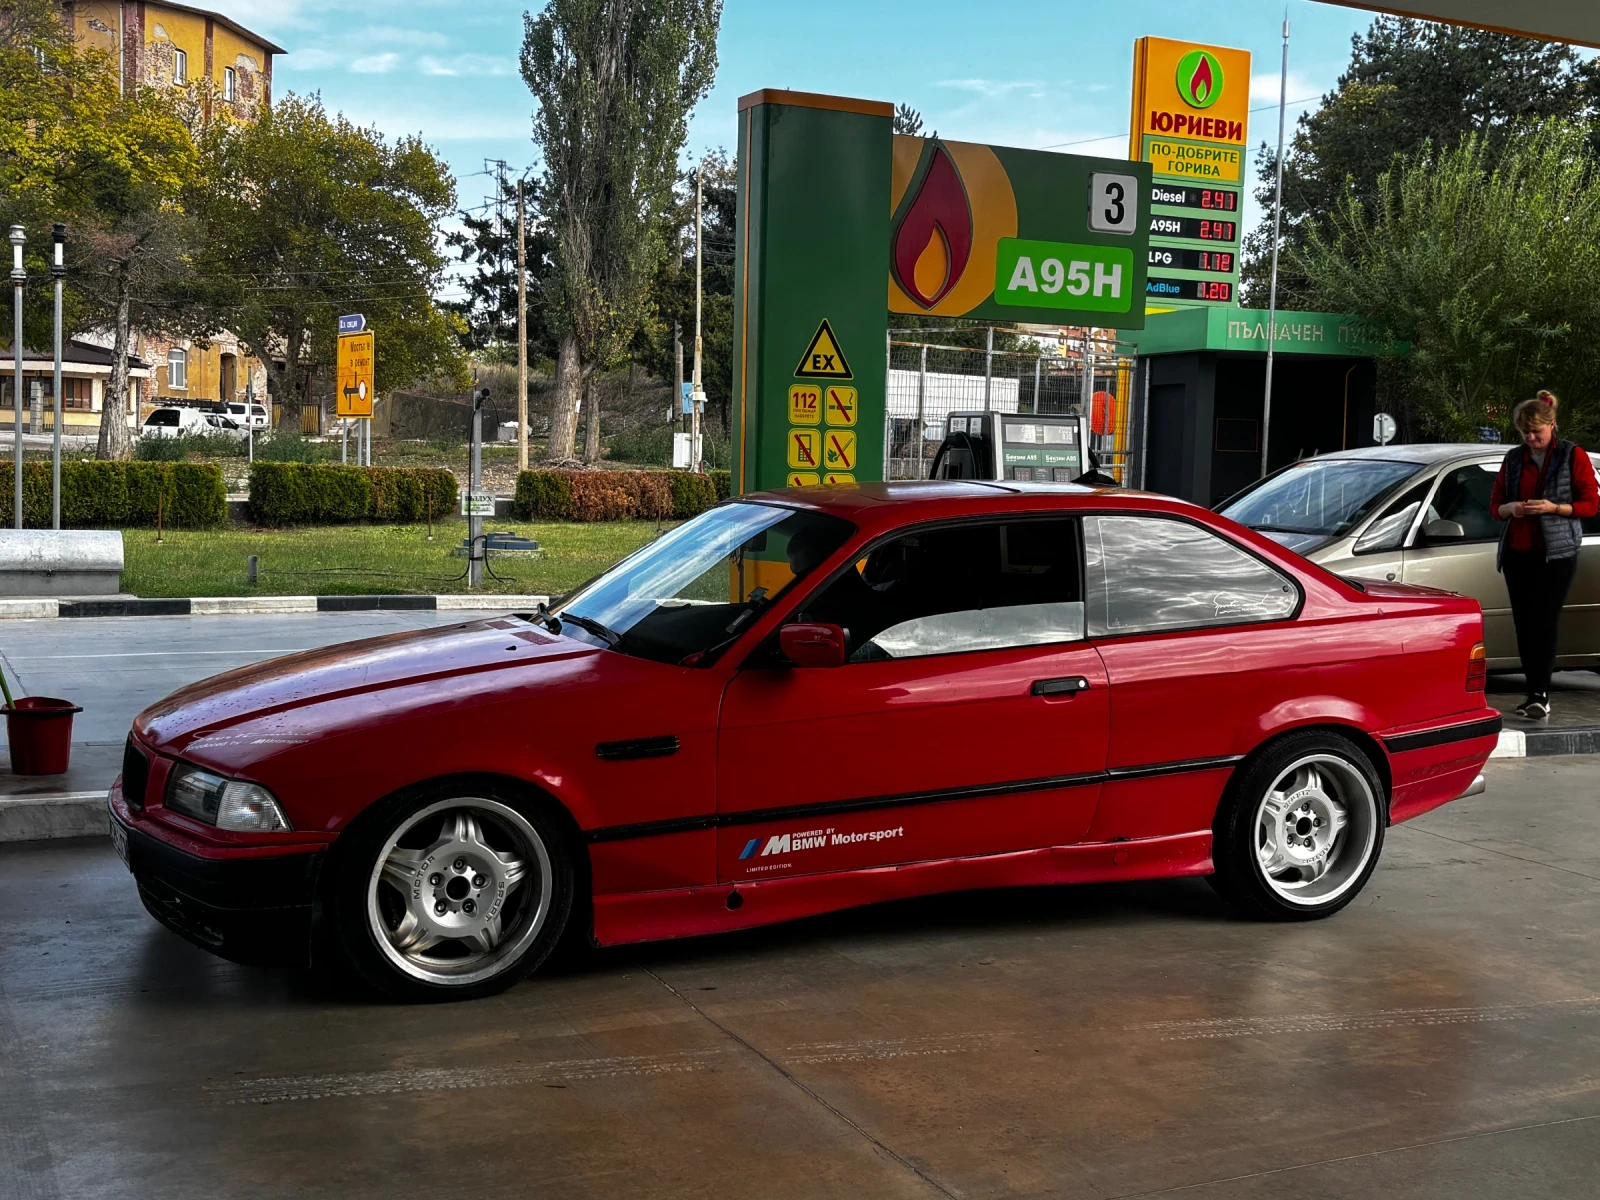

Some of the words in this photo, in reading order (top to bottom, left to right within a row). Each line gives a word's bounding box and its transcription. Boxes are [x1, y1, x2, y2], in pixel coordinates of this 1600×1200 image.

[1150, 111, 1242, 141] ЮРИЕВИ
[1151, 143, 1238, 164] ПО-ДОБРИТЕ
[1168, 160, 1221, 177] ГОРИВА
[1104, 182, 1125, 225] 3
[1151, 188, 1186, 204] Diesel
[1201, 190, 1234, 210] 2.41
[1200, 220, 1232, 240] 2.41
[1148, 251, 1173, 265] LPG
[1201, 252, 1231, 271] 1.12
[1146, 282, 1180, 294] AdBlue
[1200, 282, 1229, 300] 1.20
[812, 353, 836, 371] EX
[793, 392, 816, 408] 112
[792, 829, 823, 838] POWERED
[792, 836, 826, 851] BMW
[831, 826, 904, 846] Motorsport
[413, 856, 436, 900] MOTOR
[746, 865, 769, 873] LIMITED
[485, 881, 505, 923] SPORT
